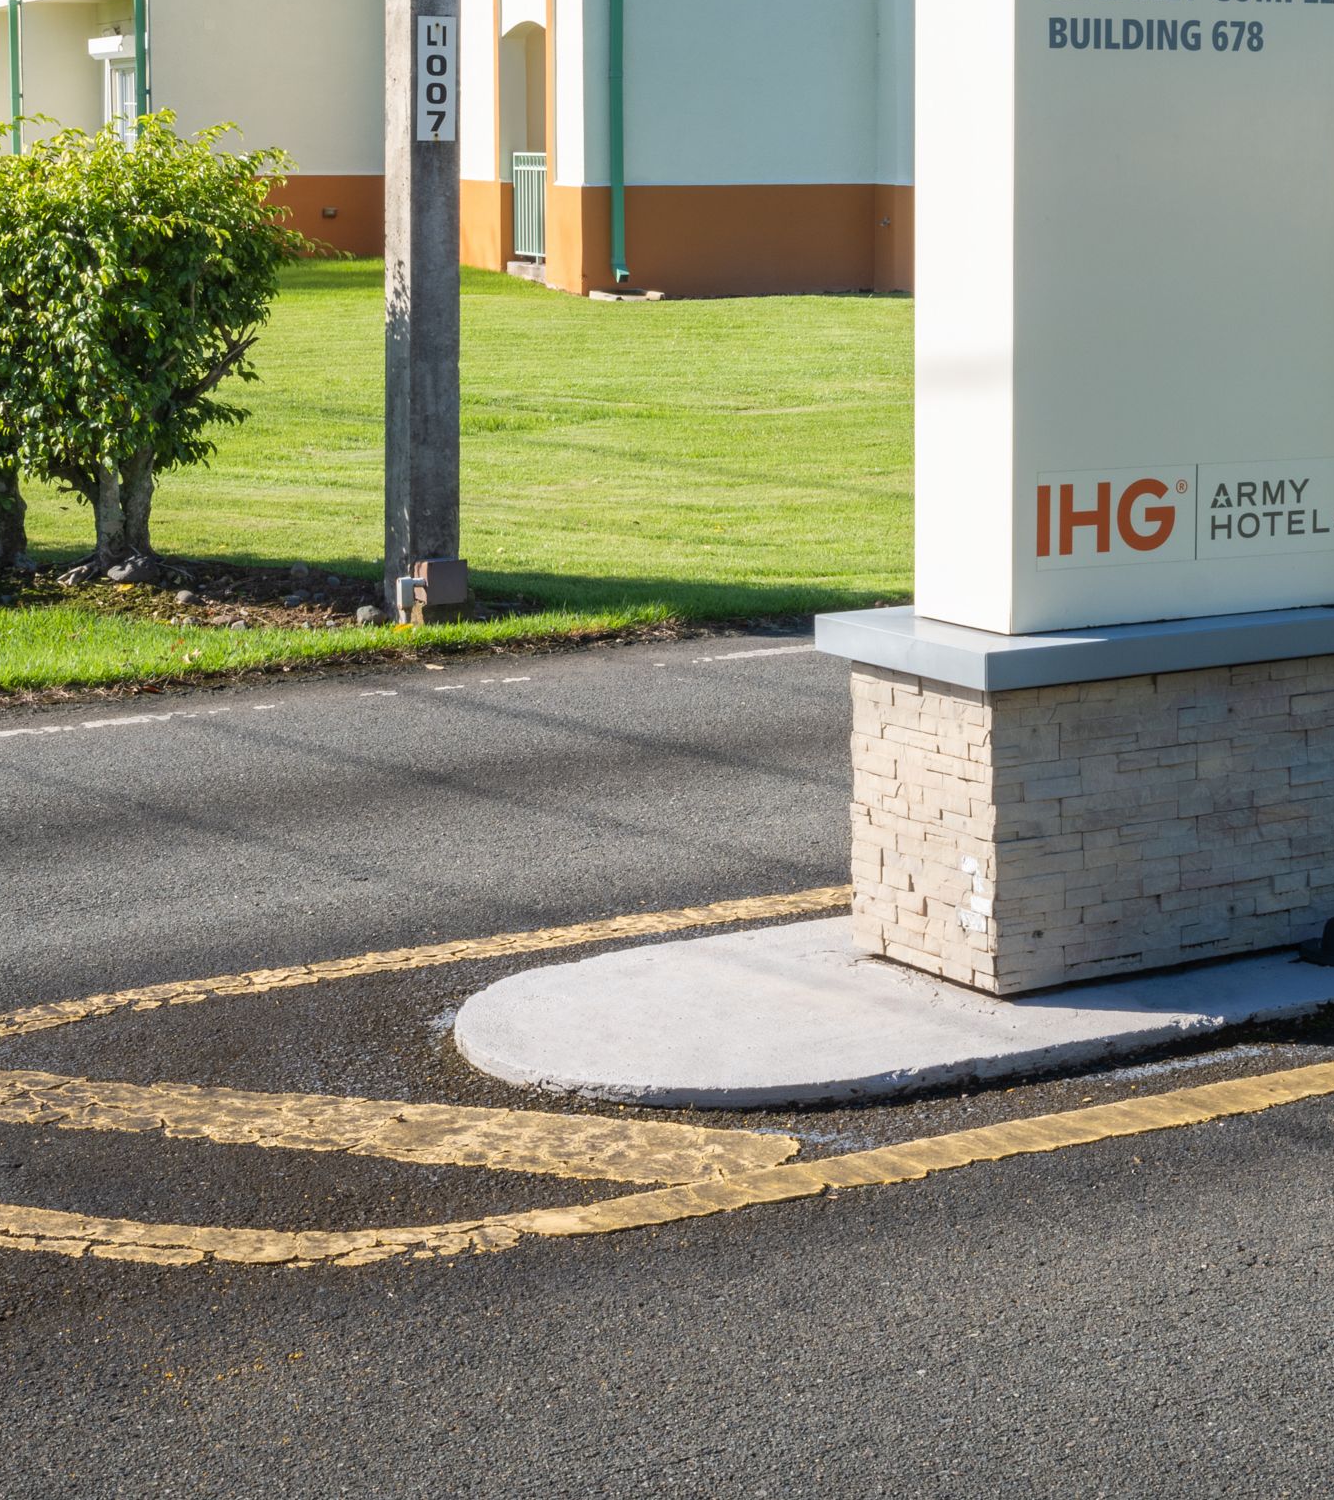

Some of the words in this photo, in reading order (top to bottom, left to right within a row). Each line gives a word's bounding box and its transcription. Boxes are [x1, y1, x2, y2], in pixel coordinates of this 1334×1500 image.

[1048, 17, 1202, 51] BUILDING
[1211, 20, 1264, 52] 678
[1210, 478, 1310, 509] ARMY
